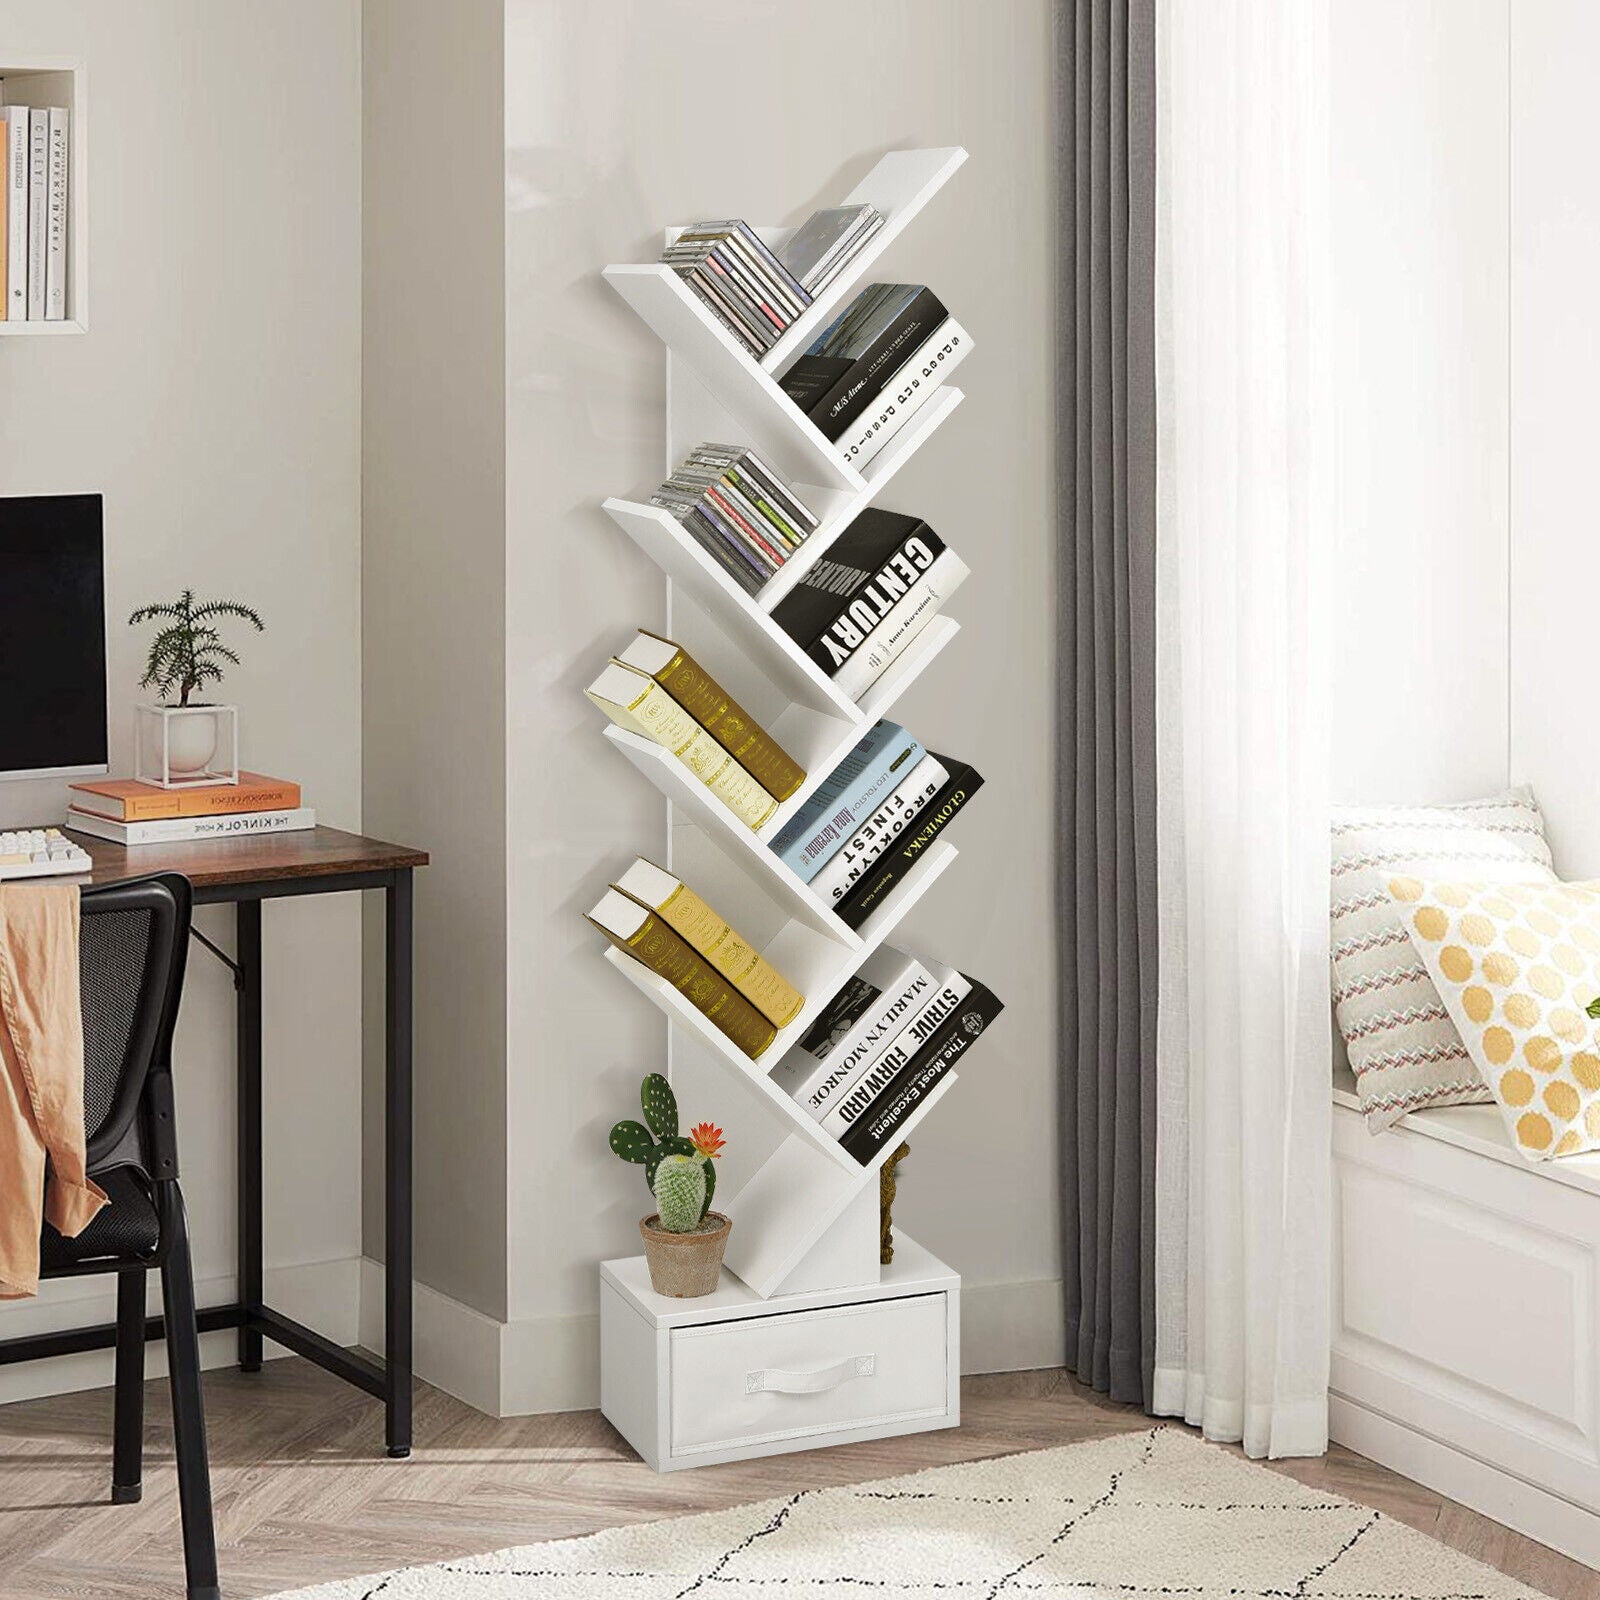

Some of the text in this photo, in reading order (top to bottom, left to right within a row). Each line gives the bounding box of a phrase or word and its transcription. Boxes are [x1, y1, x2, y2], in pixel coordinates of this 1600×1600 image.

[921, 336, 960, 378] speed
[897, 379, 920, 404] and
[798, 558, 871, 597] CENTURY
[820, 537, 934, 667] CENTURY
[889, 628, 905, 646] Anna
[852, 772, 889, 813] LEO TOLSTOY
[832, 806, 856, 830] Anna
[843, 795, 904, 864] FINEST
[804, 824, 841, 859] Karenina
[832, 783, 936, 899] BROOKLYN'S
[808, 975, 928, 1109] MARILYN MONROE
[838, 988, 959, 1123] STRIVE FORWARD
[871, 1038, 967, 1139] The Most Excellent
